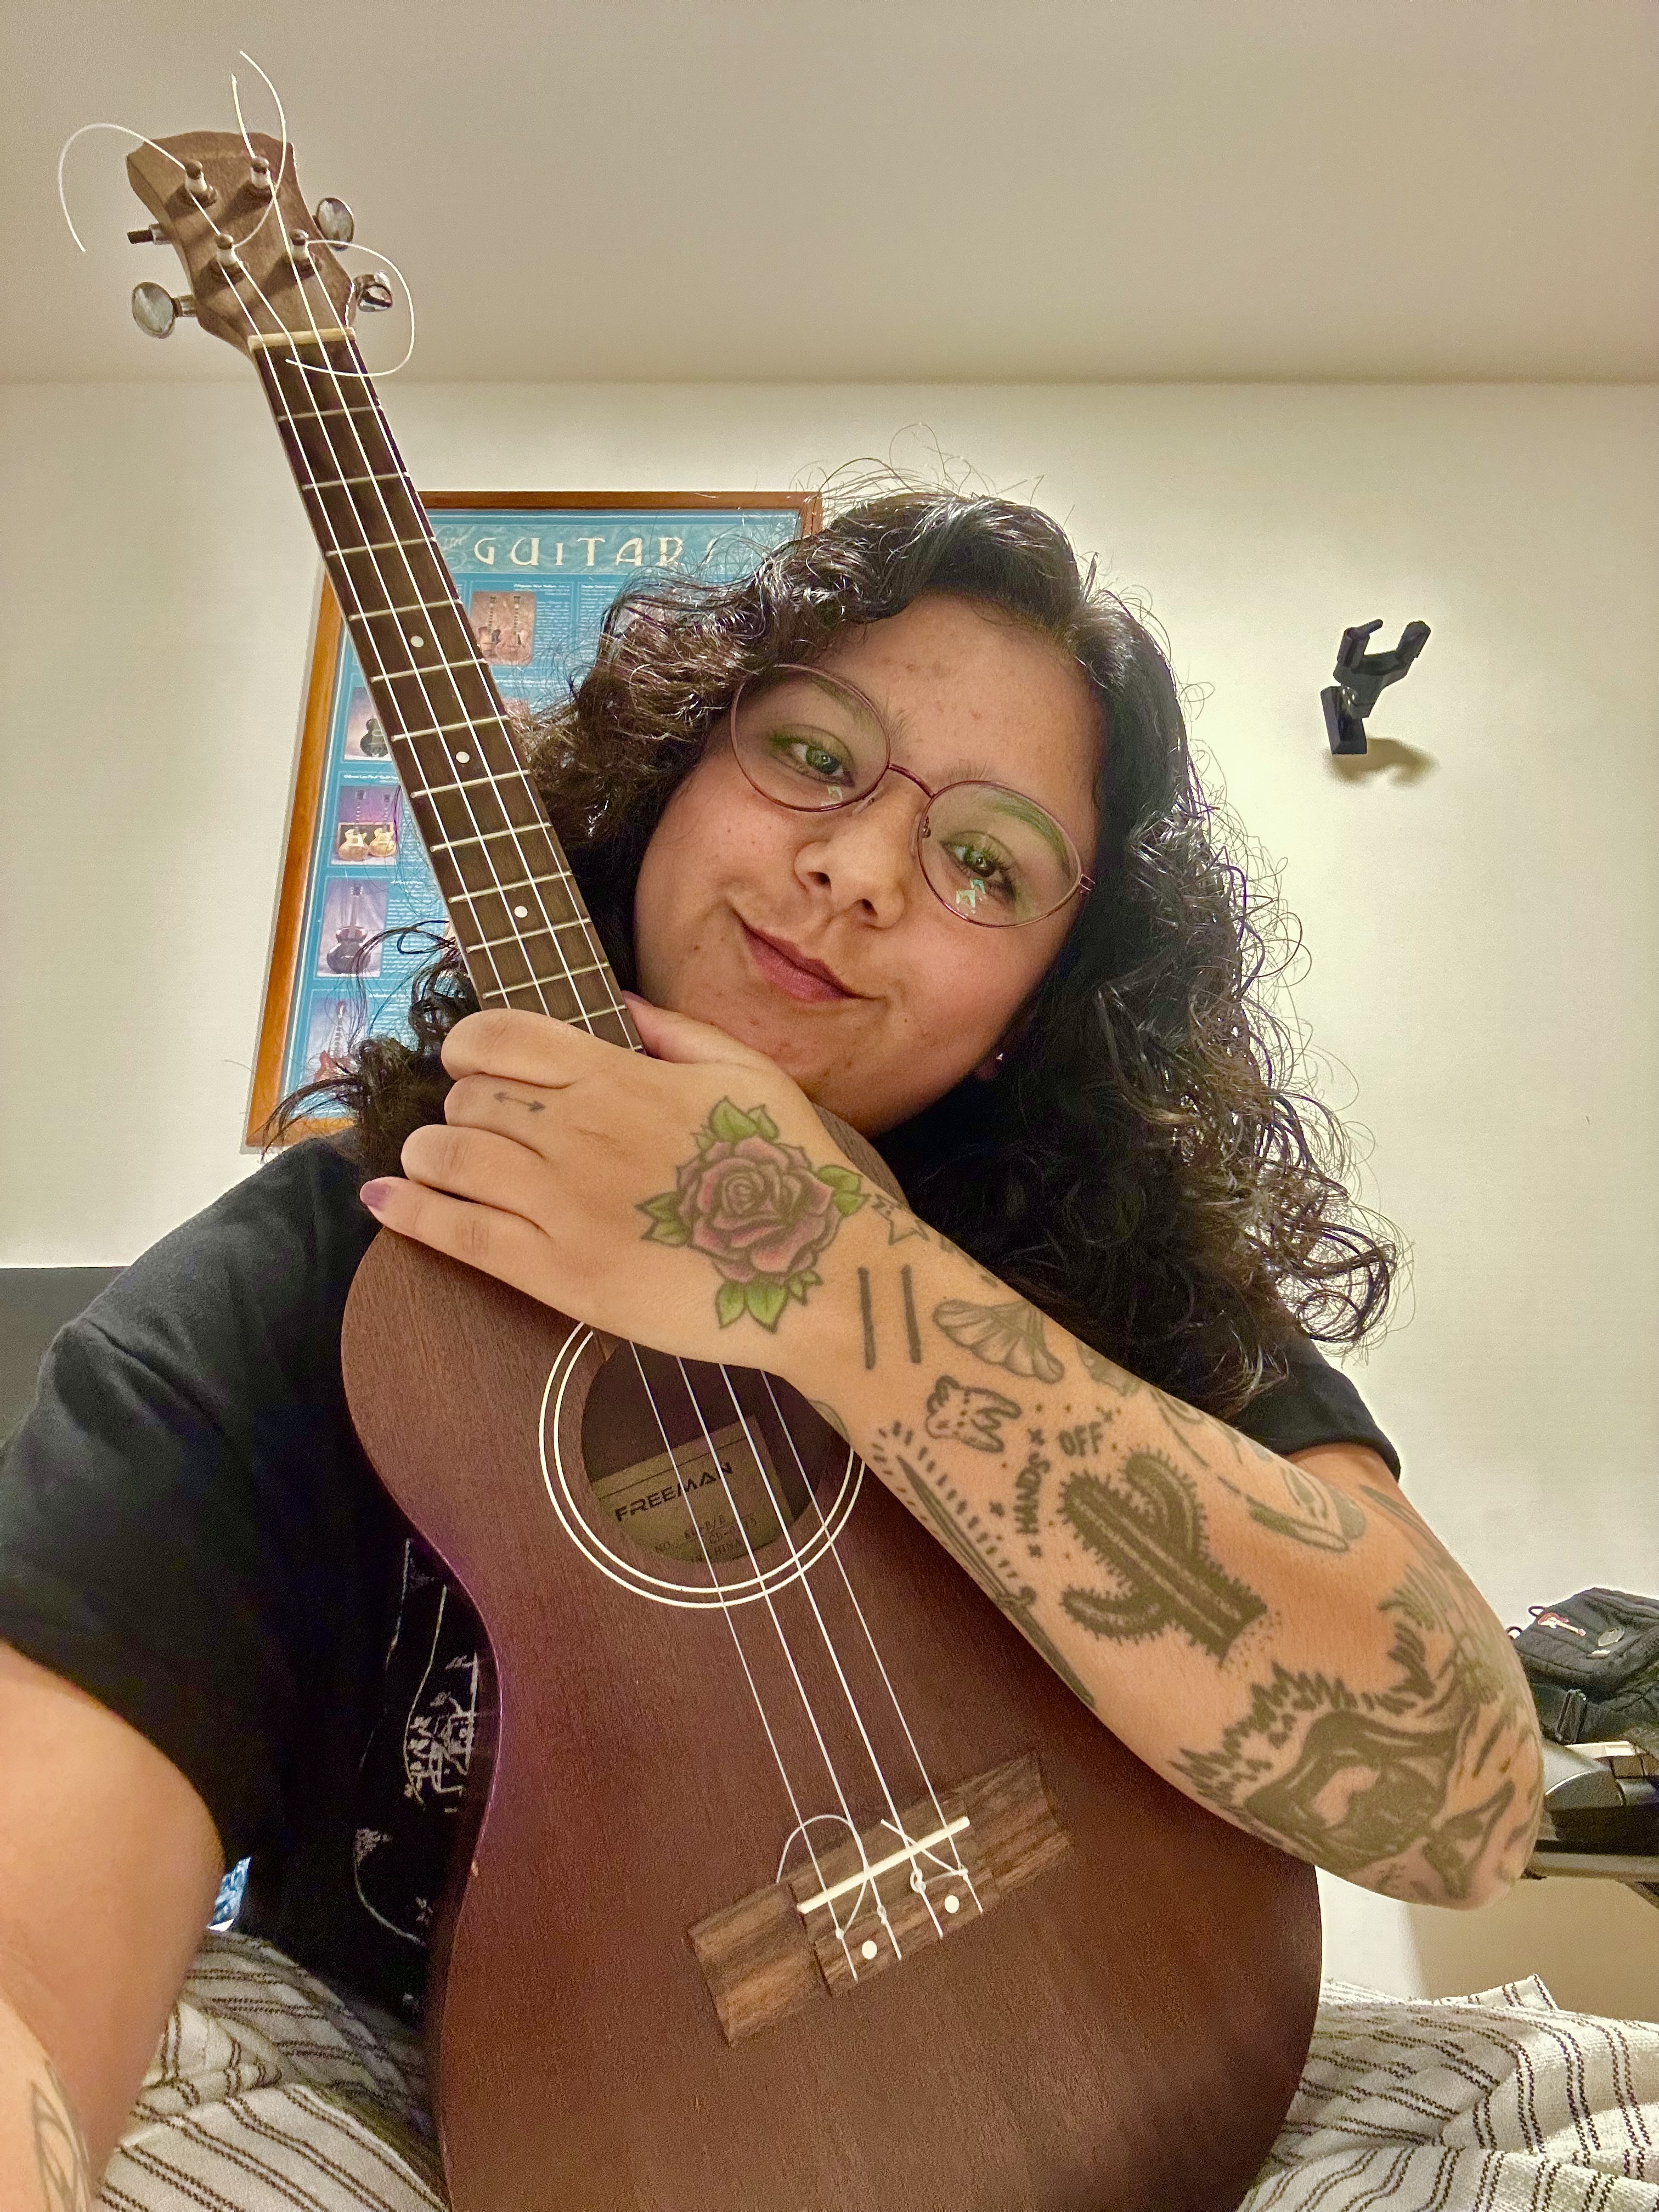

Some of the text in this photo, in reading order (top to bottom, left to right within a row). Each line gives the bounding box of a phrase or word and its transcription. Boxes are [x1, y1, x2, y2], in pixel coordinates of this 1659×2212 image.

[614, 1461, 733, 1521] FREEMAN
[1014, 1421, 1104, 1534] HANDS OFF
